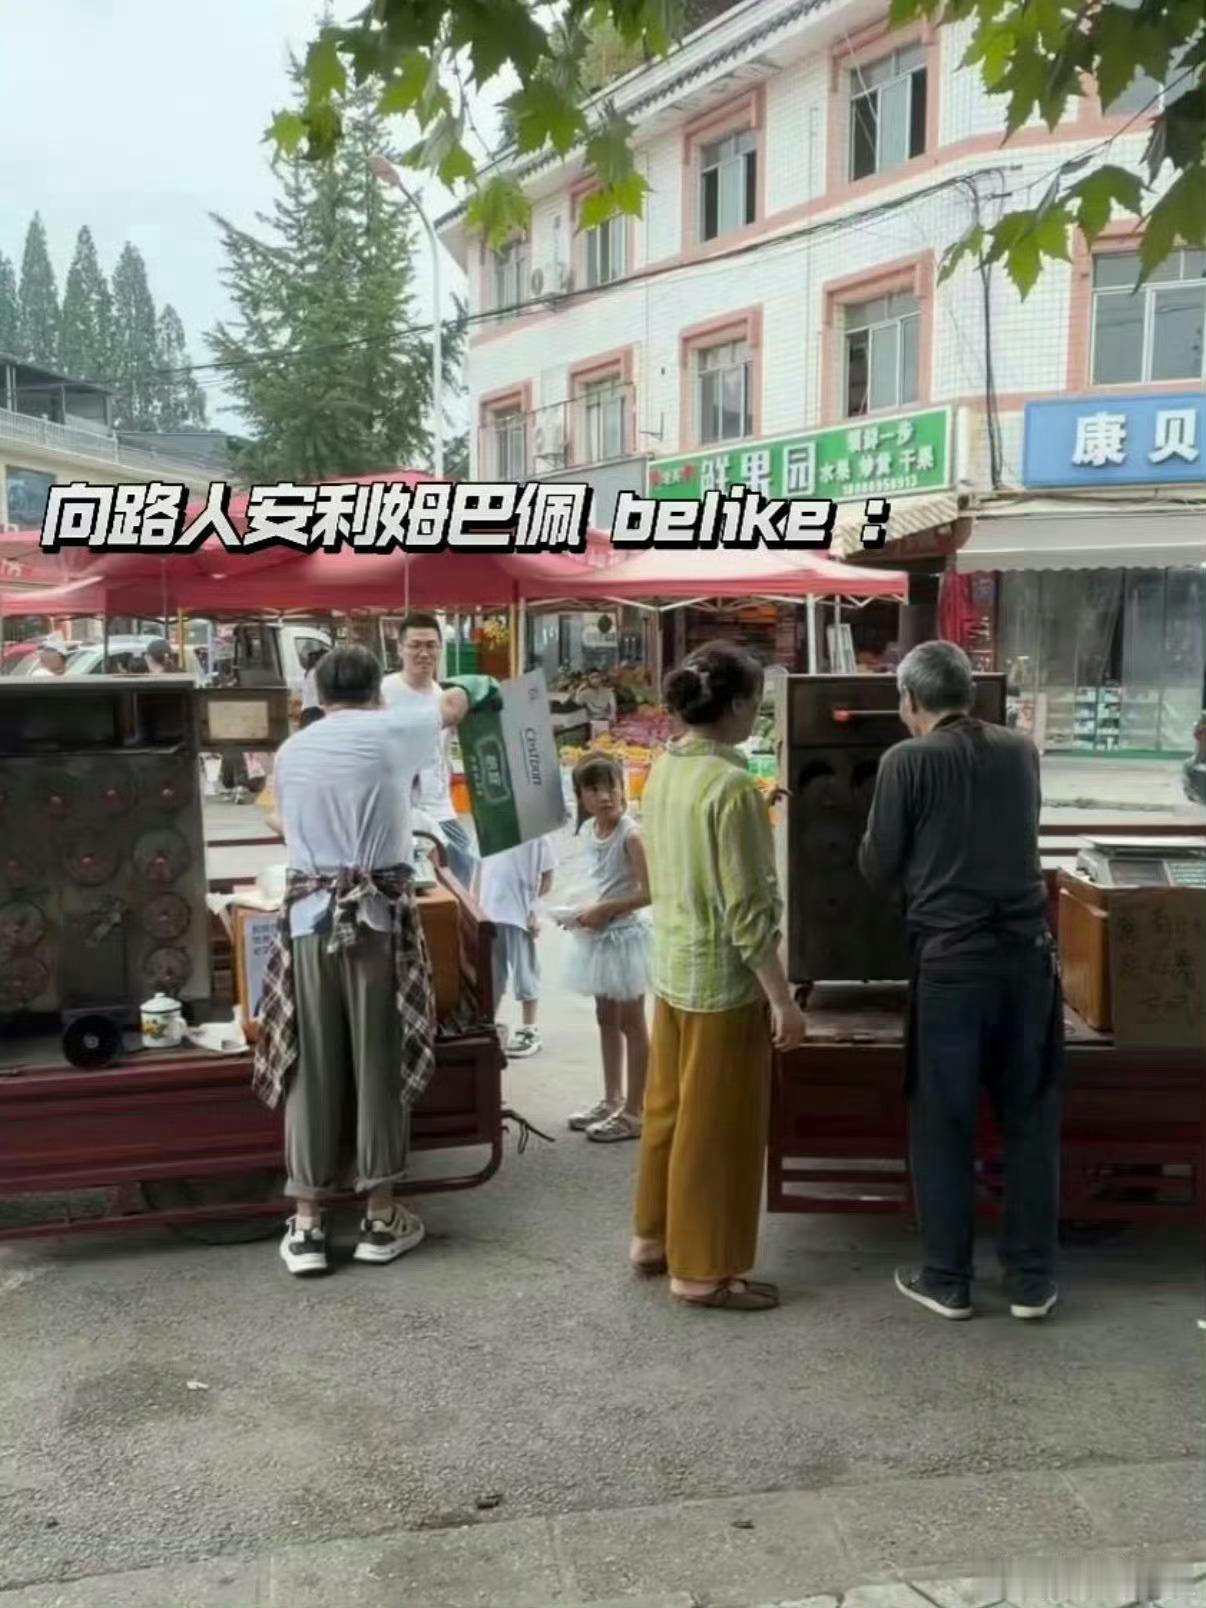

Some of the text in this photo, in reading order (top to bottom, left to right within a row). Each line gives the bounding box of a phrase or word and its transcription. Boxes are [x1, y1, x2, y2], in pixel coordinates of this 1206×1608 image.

[1071, 410, 1200, 467] 康贝
[819, 458, 851, 484] 水果
[899, 445, 934, 471] 干果
